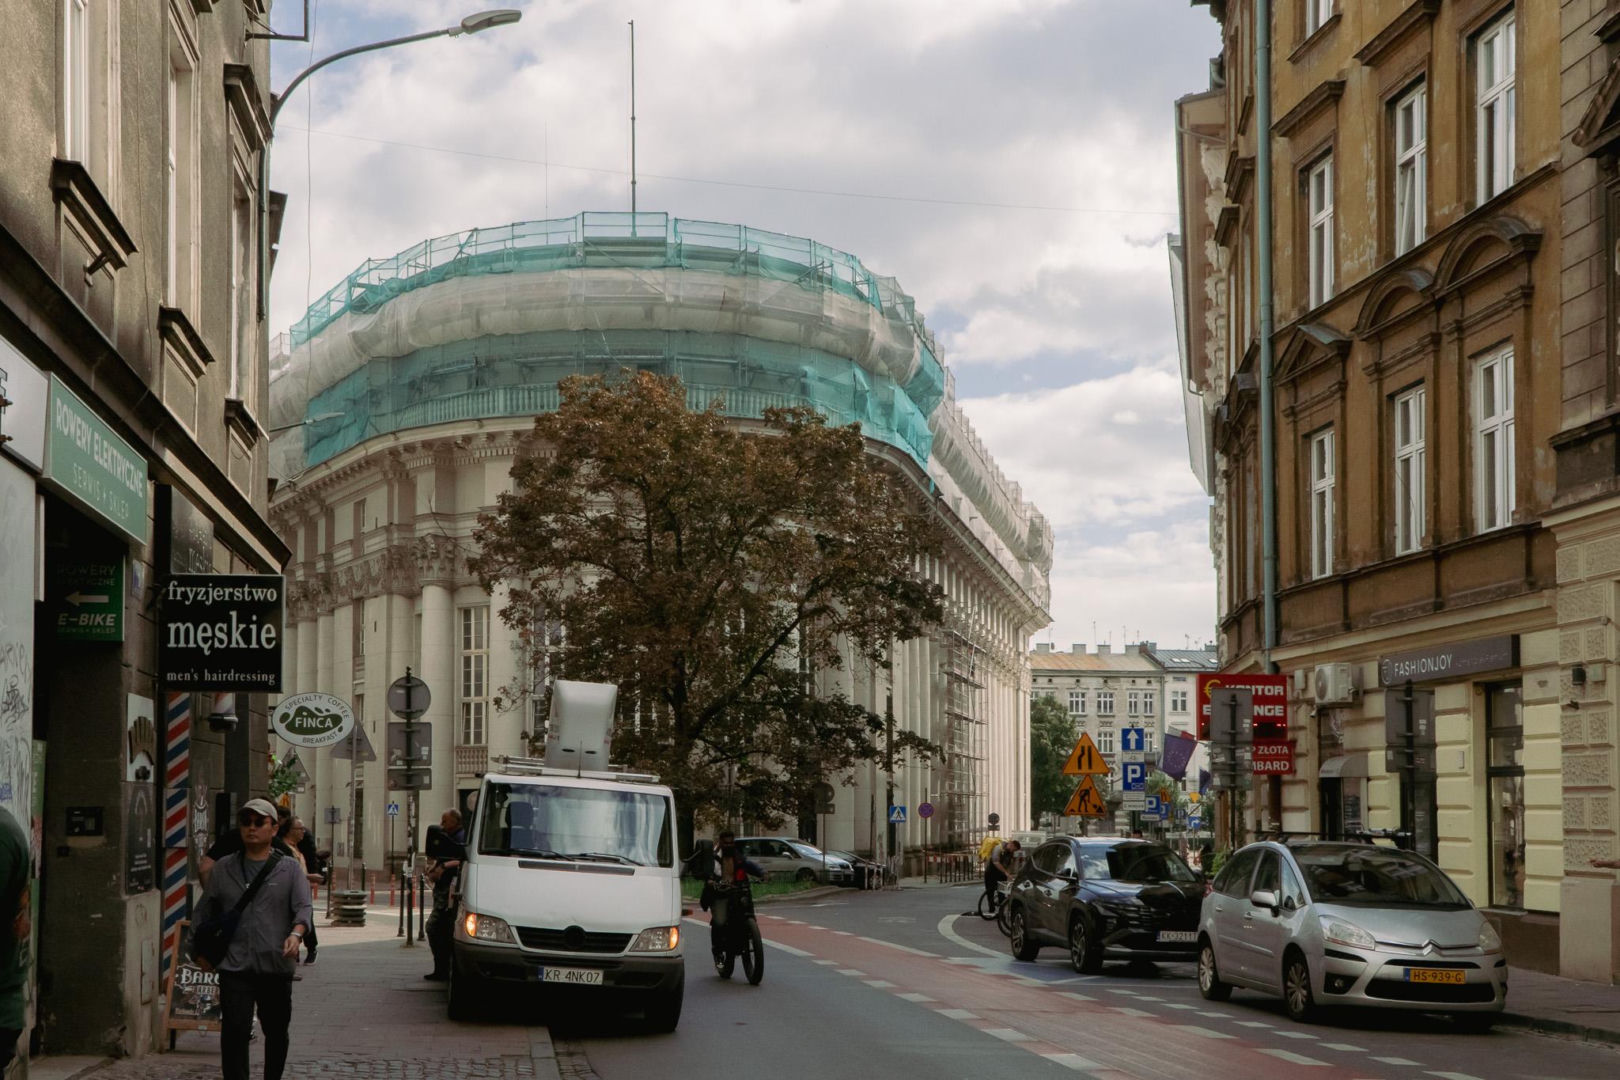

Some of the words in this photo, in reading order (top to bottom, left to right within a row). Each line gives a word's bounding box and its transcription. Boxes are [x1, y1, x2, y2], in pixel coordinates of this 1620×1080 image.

[56, 397, 92, 455] ROWERY
[94, 431, 143, 498] ELEKTRYCZNE
[168, 580, 277, 605] fryzjerstwo
[58, 613, 116, 626] E-BIKE
[167, 610, 276, 656] męskie
[1394, 654, 1452, 677] FASHIONJOY
[166, 668, 199, 681] men's
[204, 668, 276, 686] hairdressing
[285, 694, 323, 710] SPECIALTY
[328, 697, 350, 719] COFFEE
[295, 717, 333, 728] FINCA
[302, 731, 337, 744] BREAKFAST
[1258, 746, 1289, 754] ZŁOTA
[1127, 765, 1141, 783] P
[545, 969, 561, 981] KR
[565, 970, 600, 983] 4NK07
